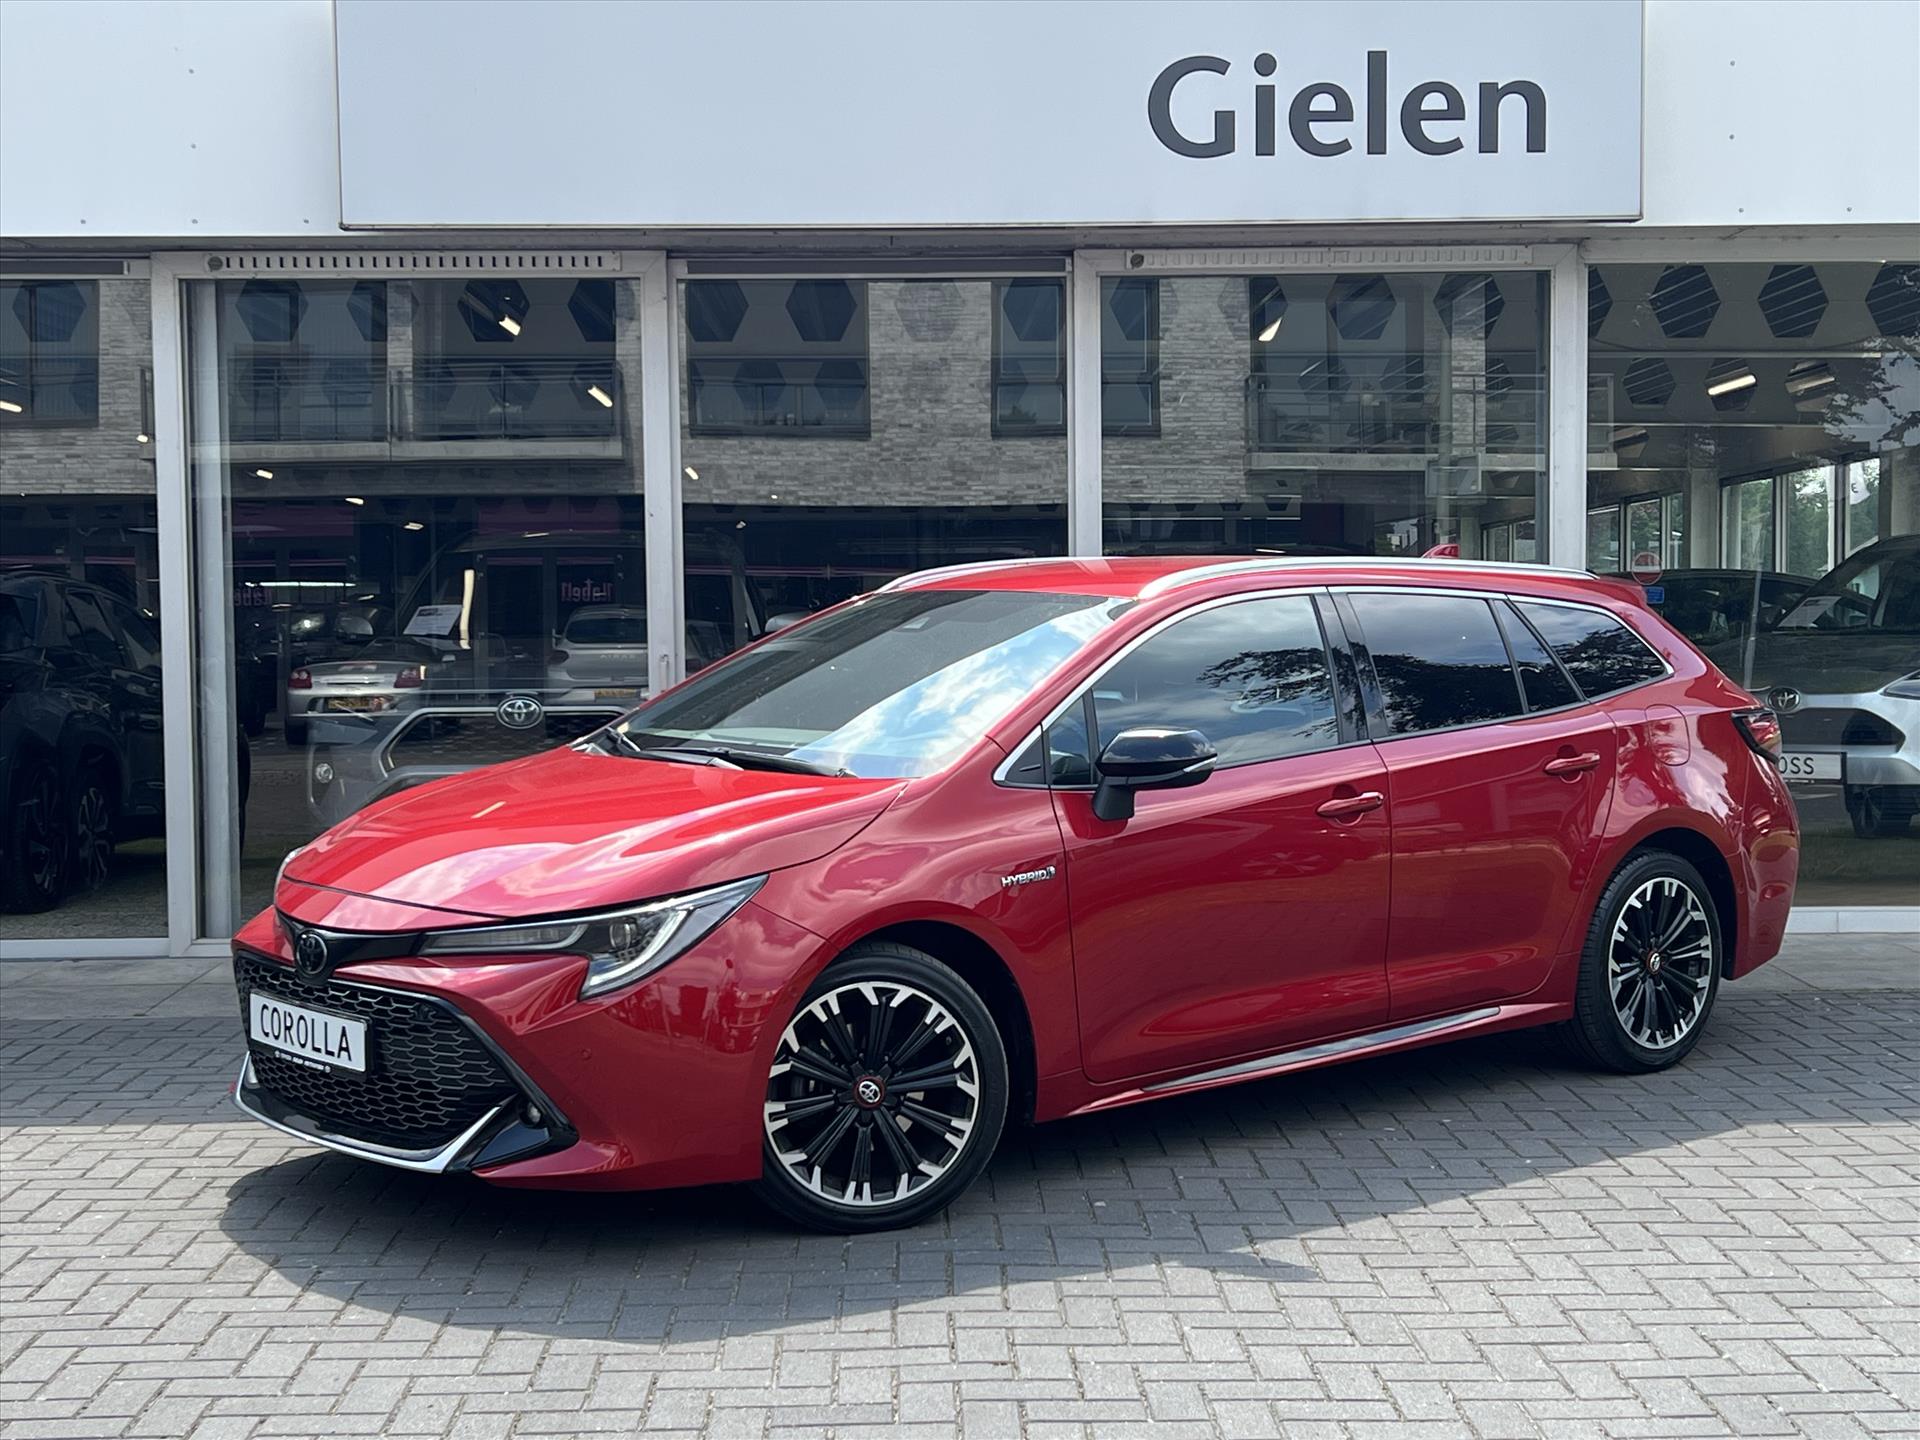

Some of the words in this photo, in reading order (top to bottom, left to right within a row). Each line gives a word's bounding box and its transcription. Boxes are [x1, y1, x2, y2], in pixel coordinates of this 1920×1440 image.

[1147, 50, 1548, 159] Gielen
[1001, 869, 1048, 887] HYBRID
[260, 1003, 353, 1062] COROLLA
